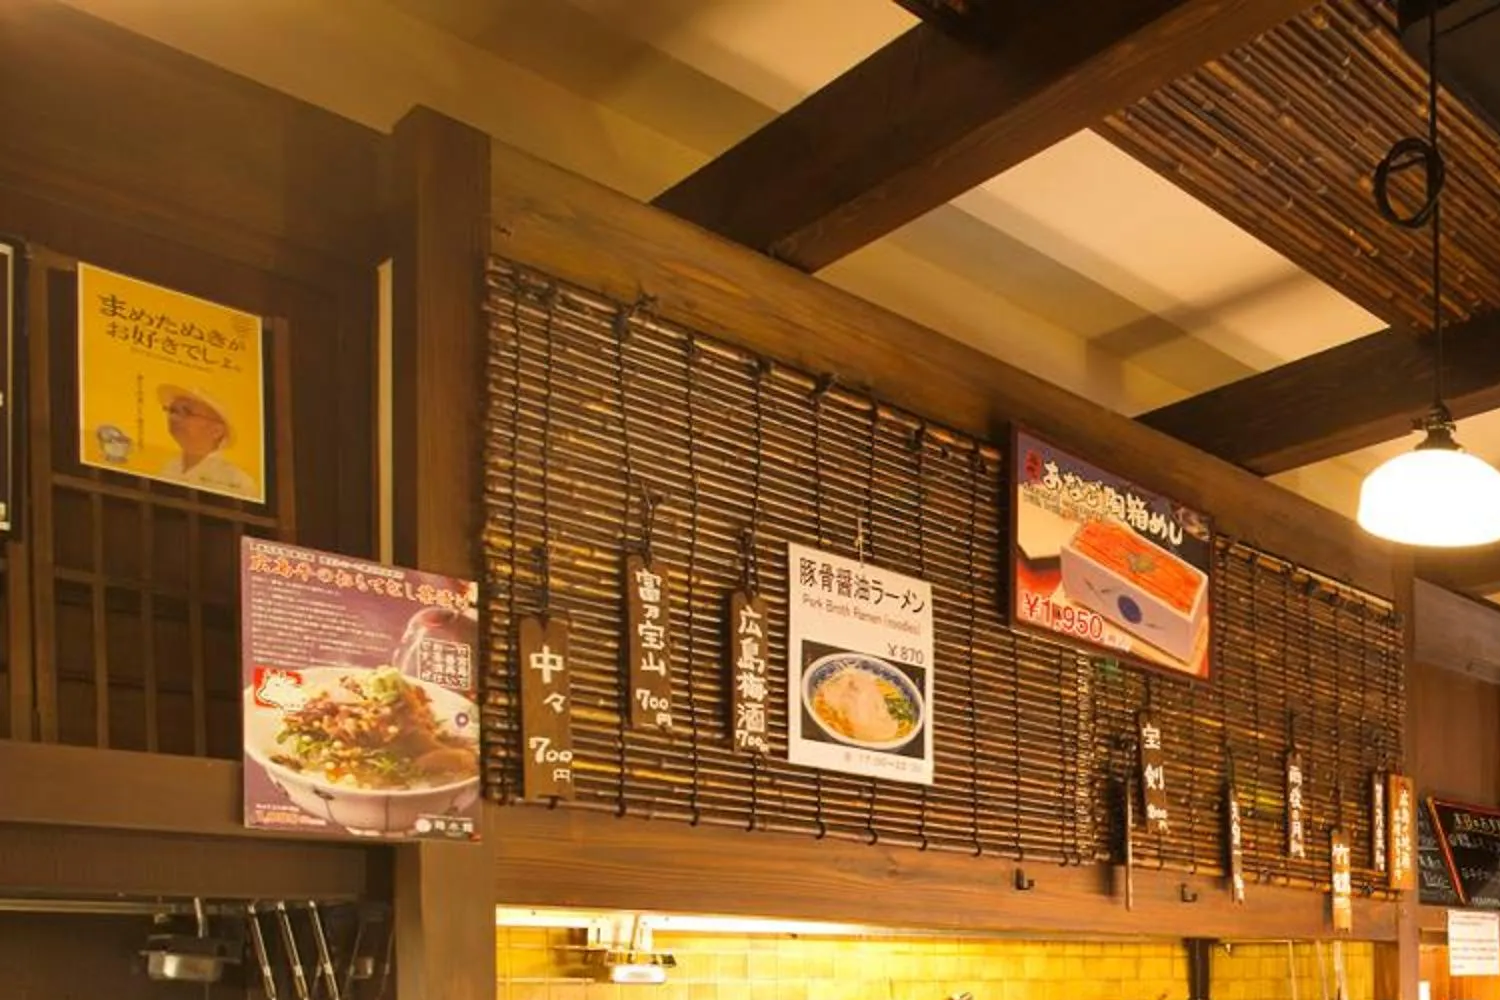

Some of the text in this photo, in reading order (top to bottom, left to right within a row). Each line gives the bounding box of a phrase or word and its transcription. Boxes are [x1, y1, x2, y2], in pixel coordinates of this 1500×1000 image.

[98, 293, 246, 351] まめたぬきが
[1043, 460, 1184, 546] あなご陶箱めし
[799, 557, 925, 614] 豚骨醤油ラーメン
[802, 592, 823, 608] Pork
[635, 567, 667, 677] 富乃宝山
[529, 645, 567, 714] 中々
[736, 605, 768, 733] 広島梅酒
